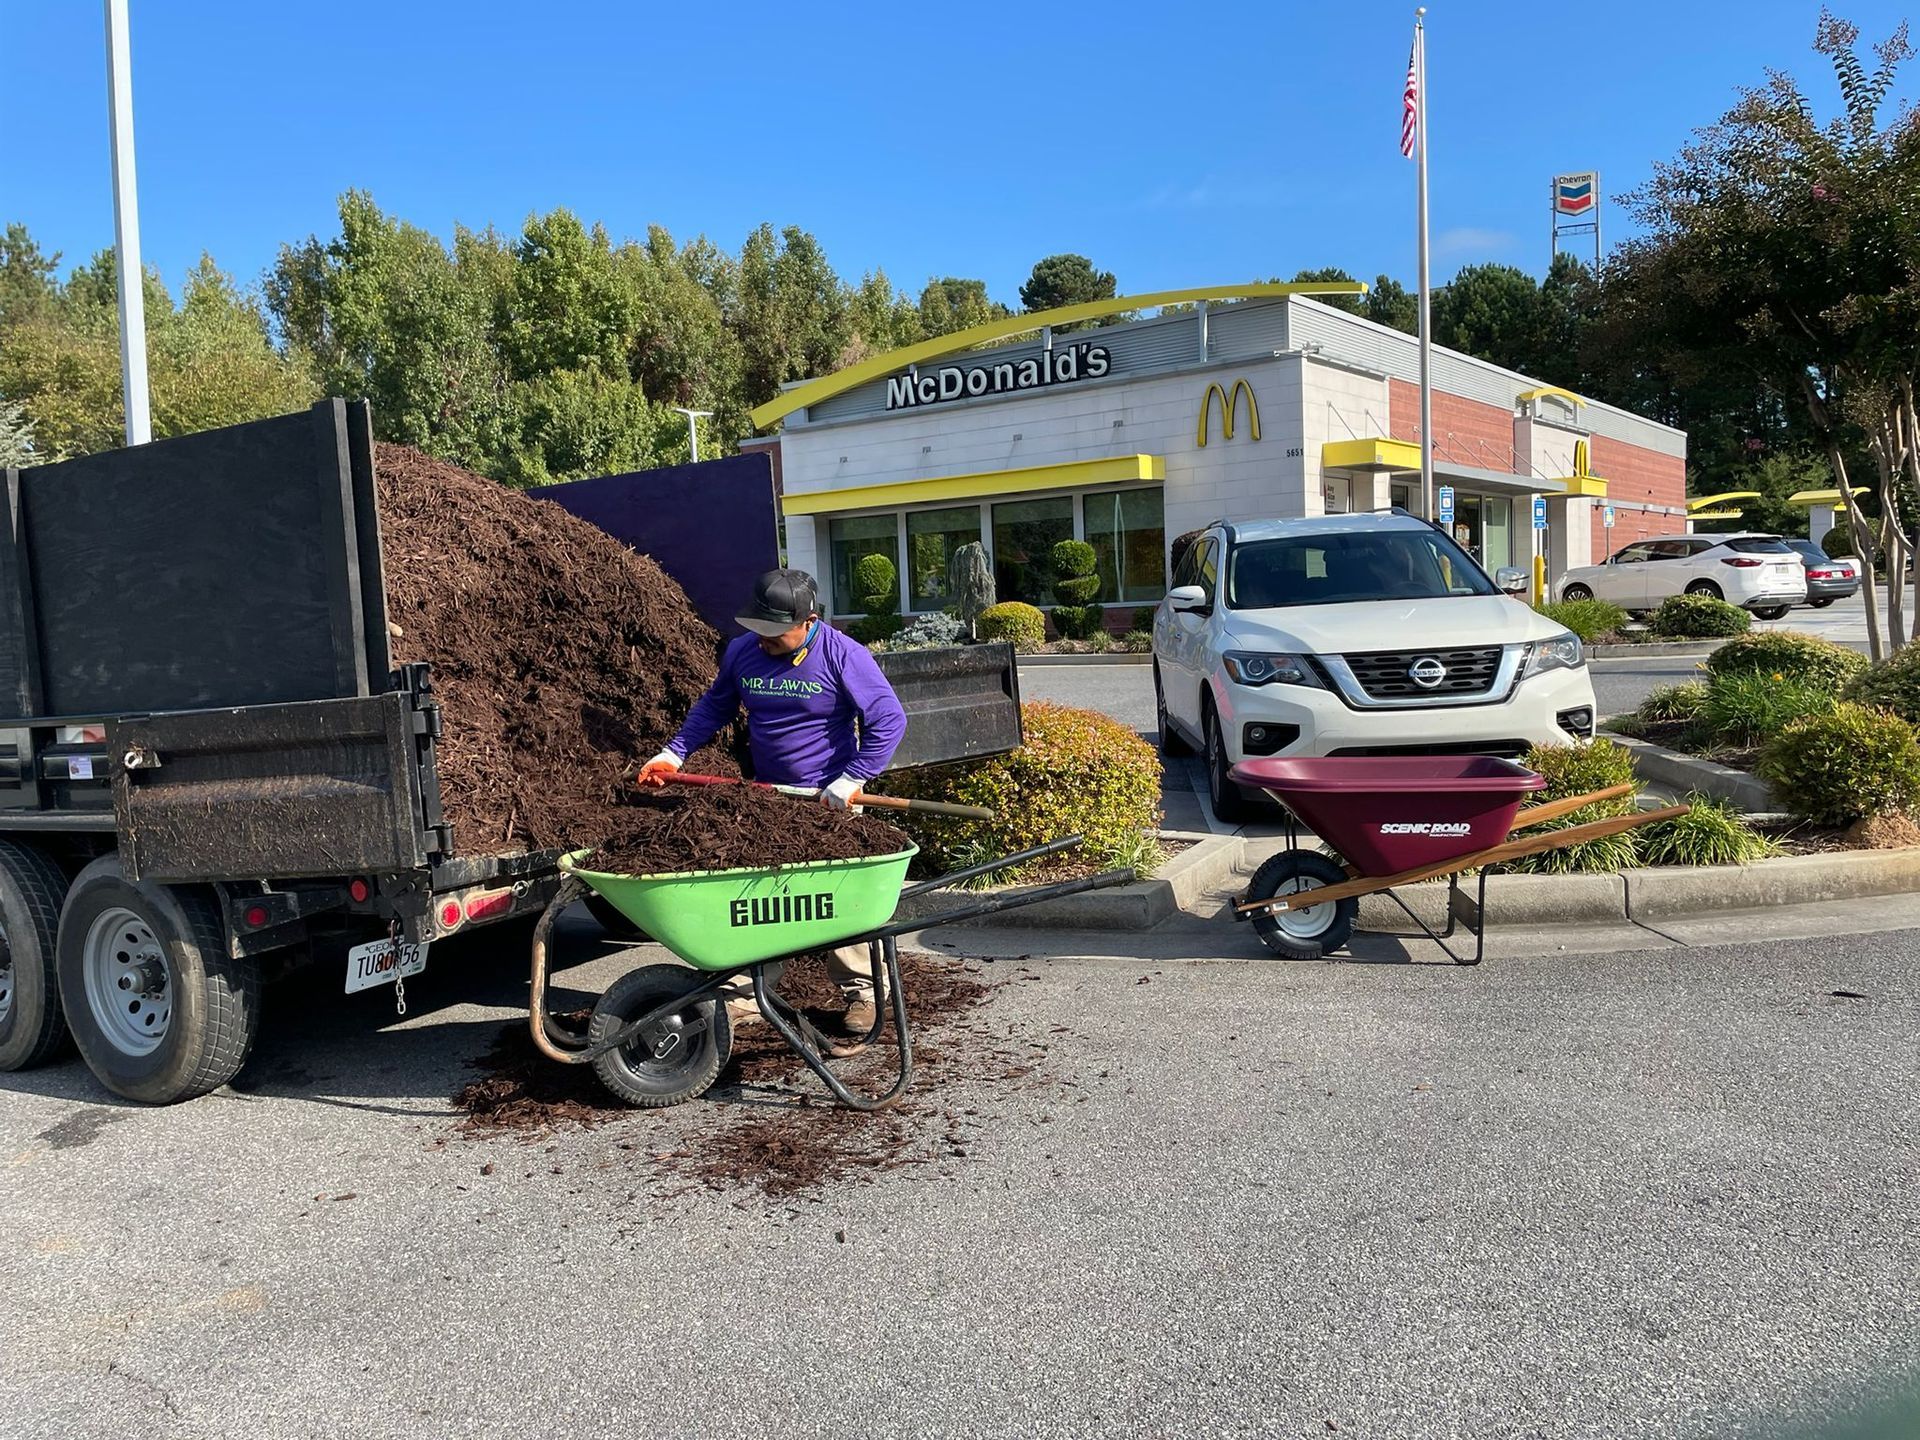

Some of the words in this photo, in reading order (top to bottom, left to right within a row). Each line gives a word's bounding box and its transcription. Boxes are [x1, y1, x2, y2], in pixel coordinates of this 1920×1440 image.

[1559, 174, 1592, 184] Chevron
[886, 342, 1111, 410] McDonald's
[1286, 448, 1304, 457] 5651
[741, 677, 765, 689] MR.
[769, 678, 823, 694] LAWNS
[1380, 823, 1432, 834] SCENIC
[1431, 823, 1471, 834] ROAD
